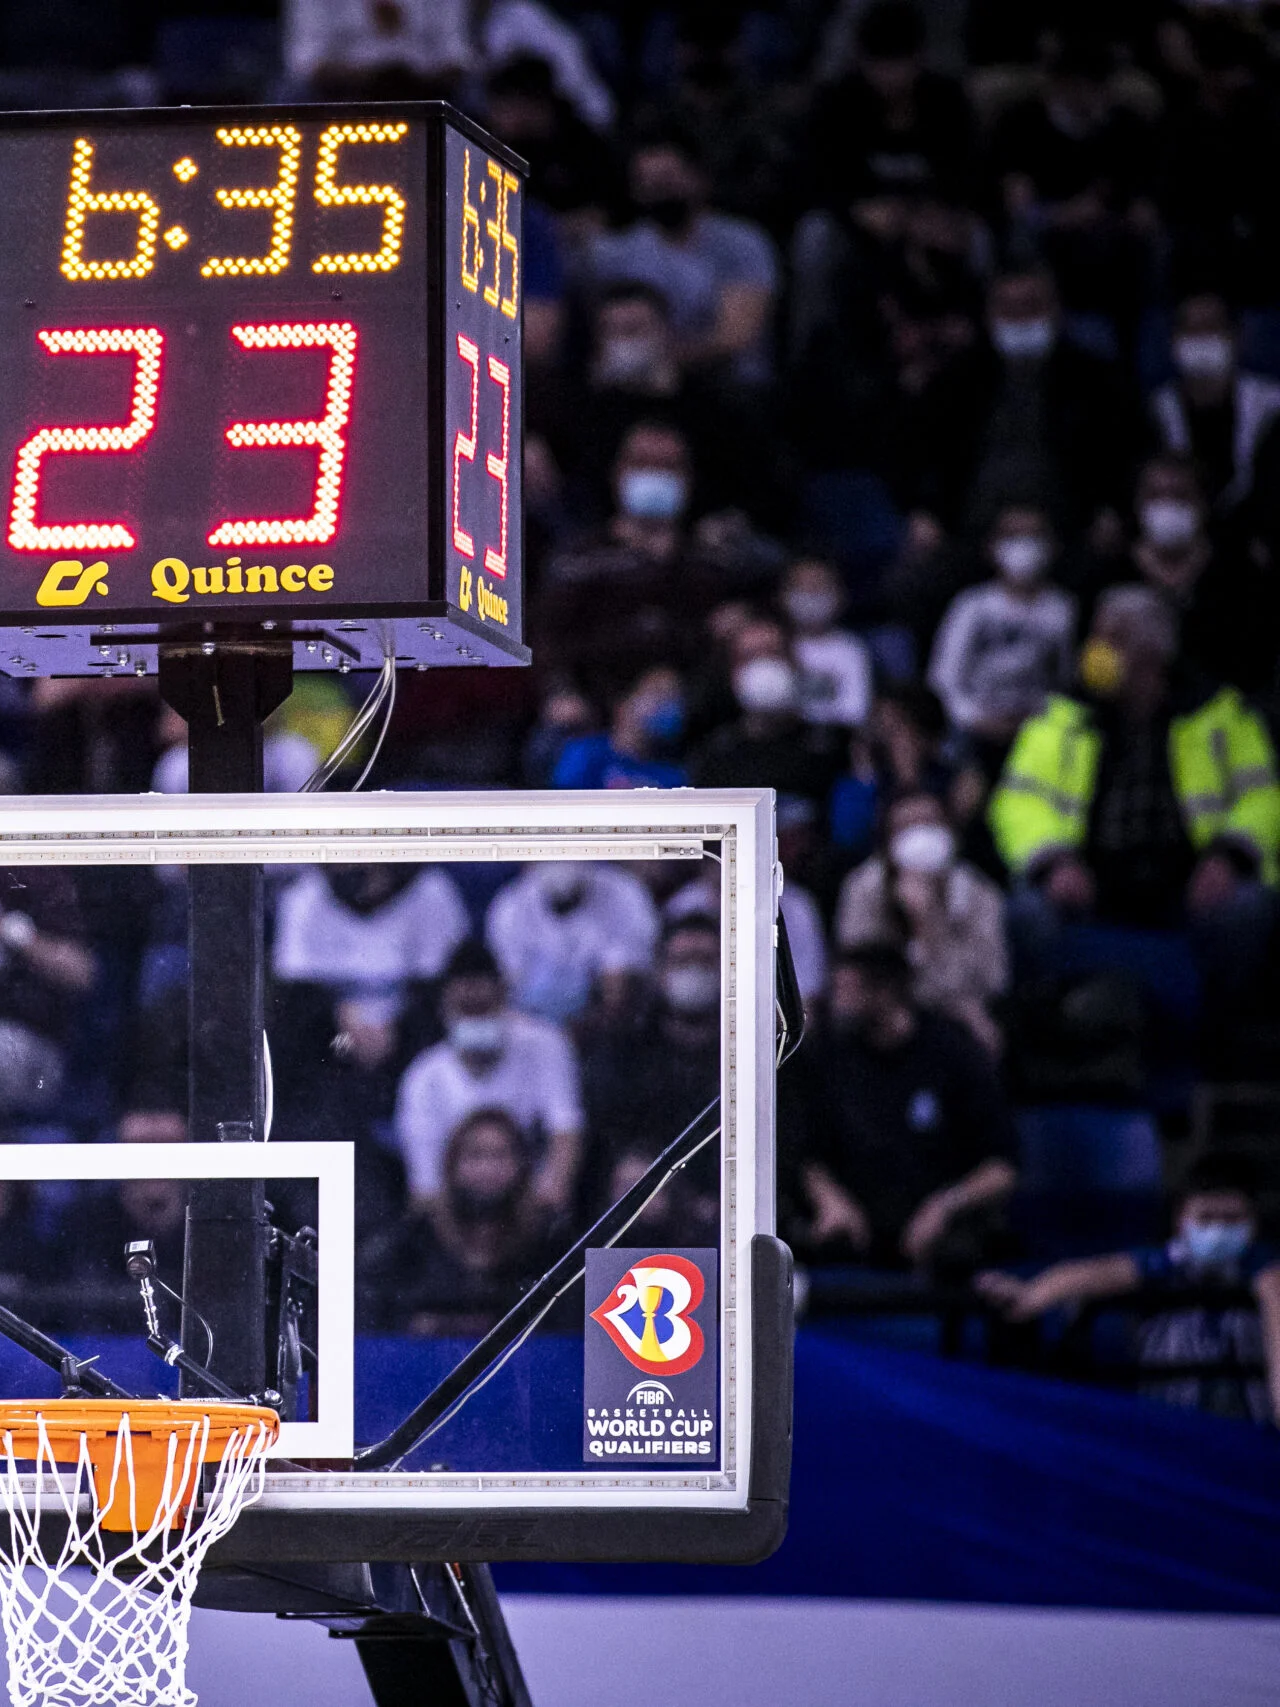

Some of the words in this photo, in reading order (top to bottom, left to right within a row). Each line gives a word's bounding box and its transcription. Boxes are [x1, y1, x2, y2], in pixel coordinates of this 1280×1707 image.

[61, 123, 408, 281] 6:35
[461, 148, 519, 320] 6:35
[6, 321, 359, 553] 23
[452, 332, 510, 579] 23
[151, 556, 335, 603] Quince
[477, 575, 509, 626] Quince
[587, 1407, 710, 1418] BASKETBALL
[636, 1391, 664, 1405] FIBA
[586, 1419, 665, 1437] WORLD
[669, 1419, 714, 1437] CUP
[588, 1440, 711, 1457] QUALIFIERS
